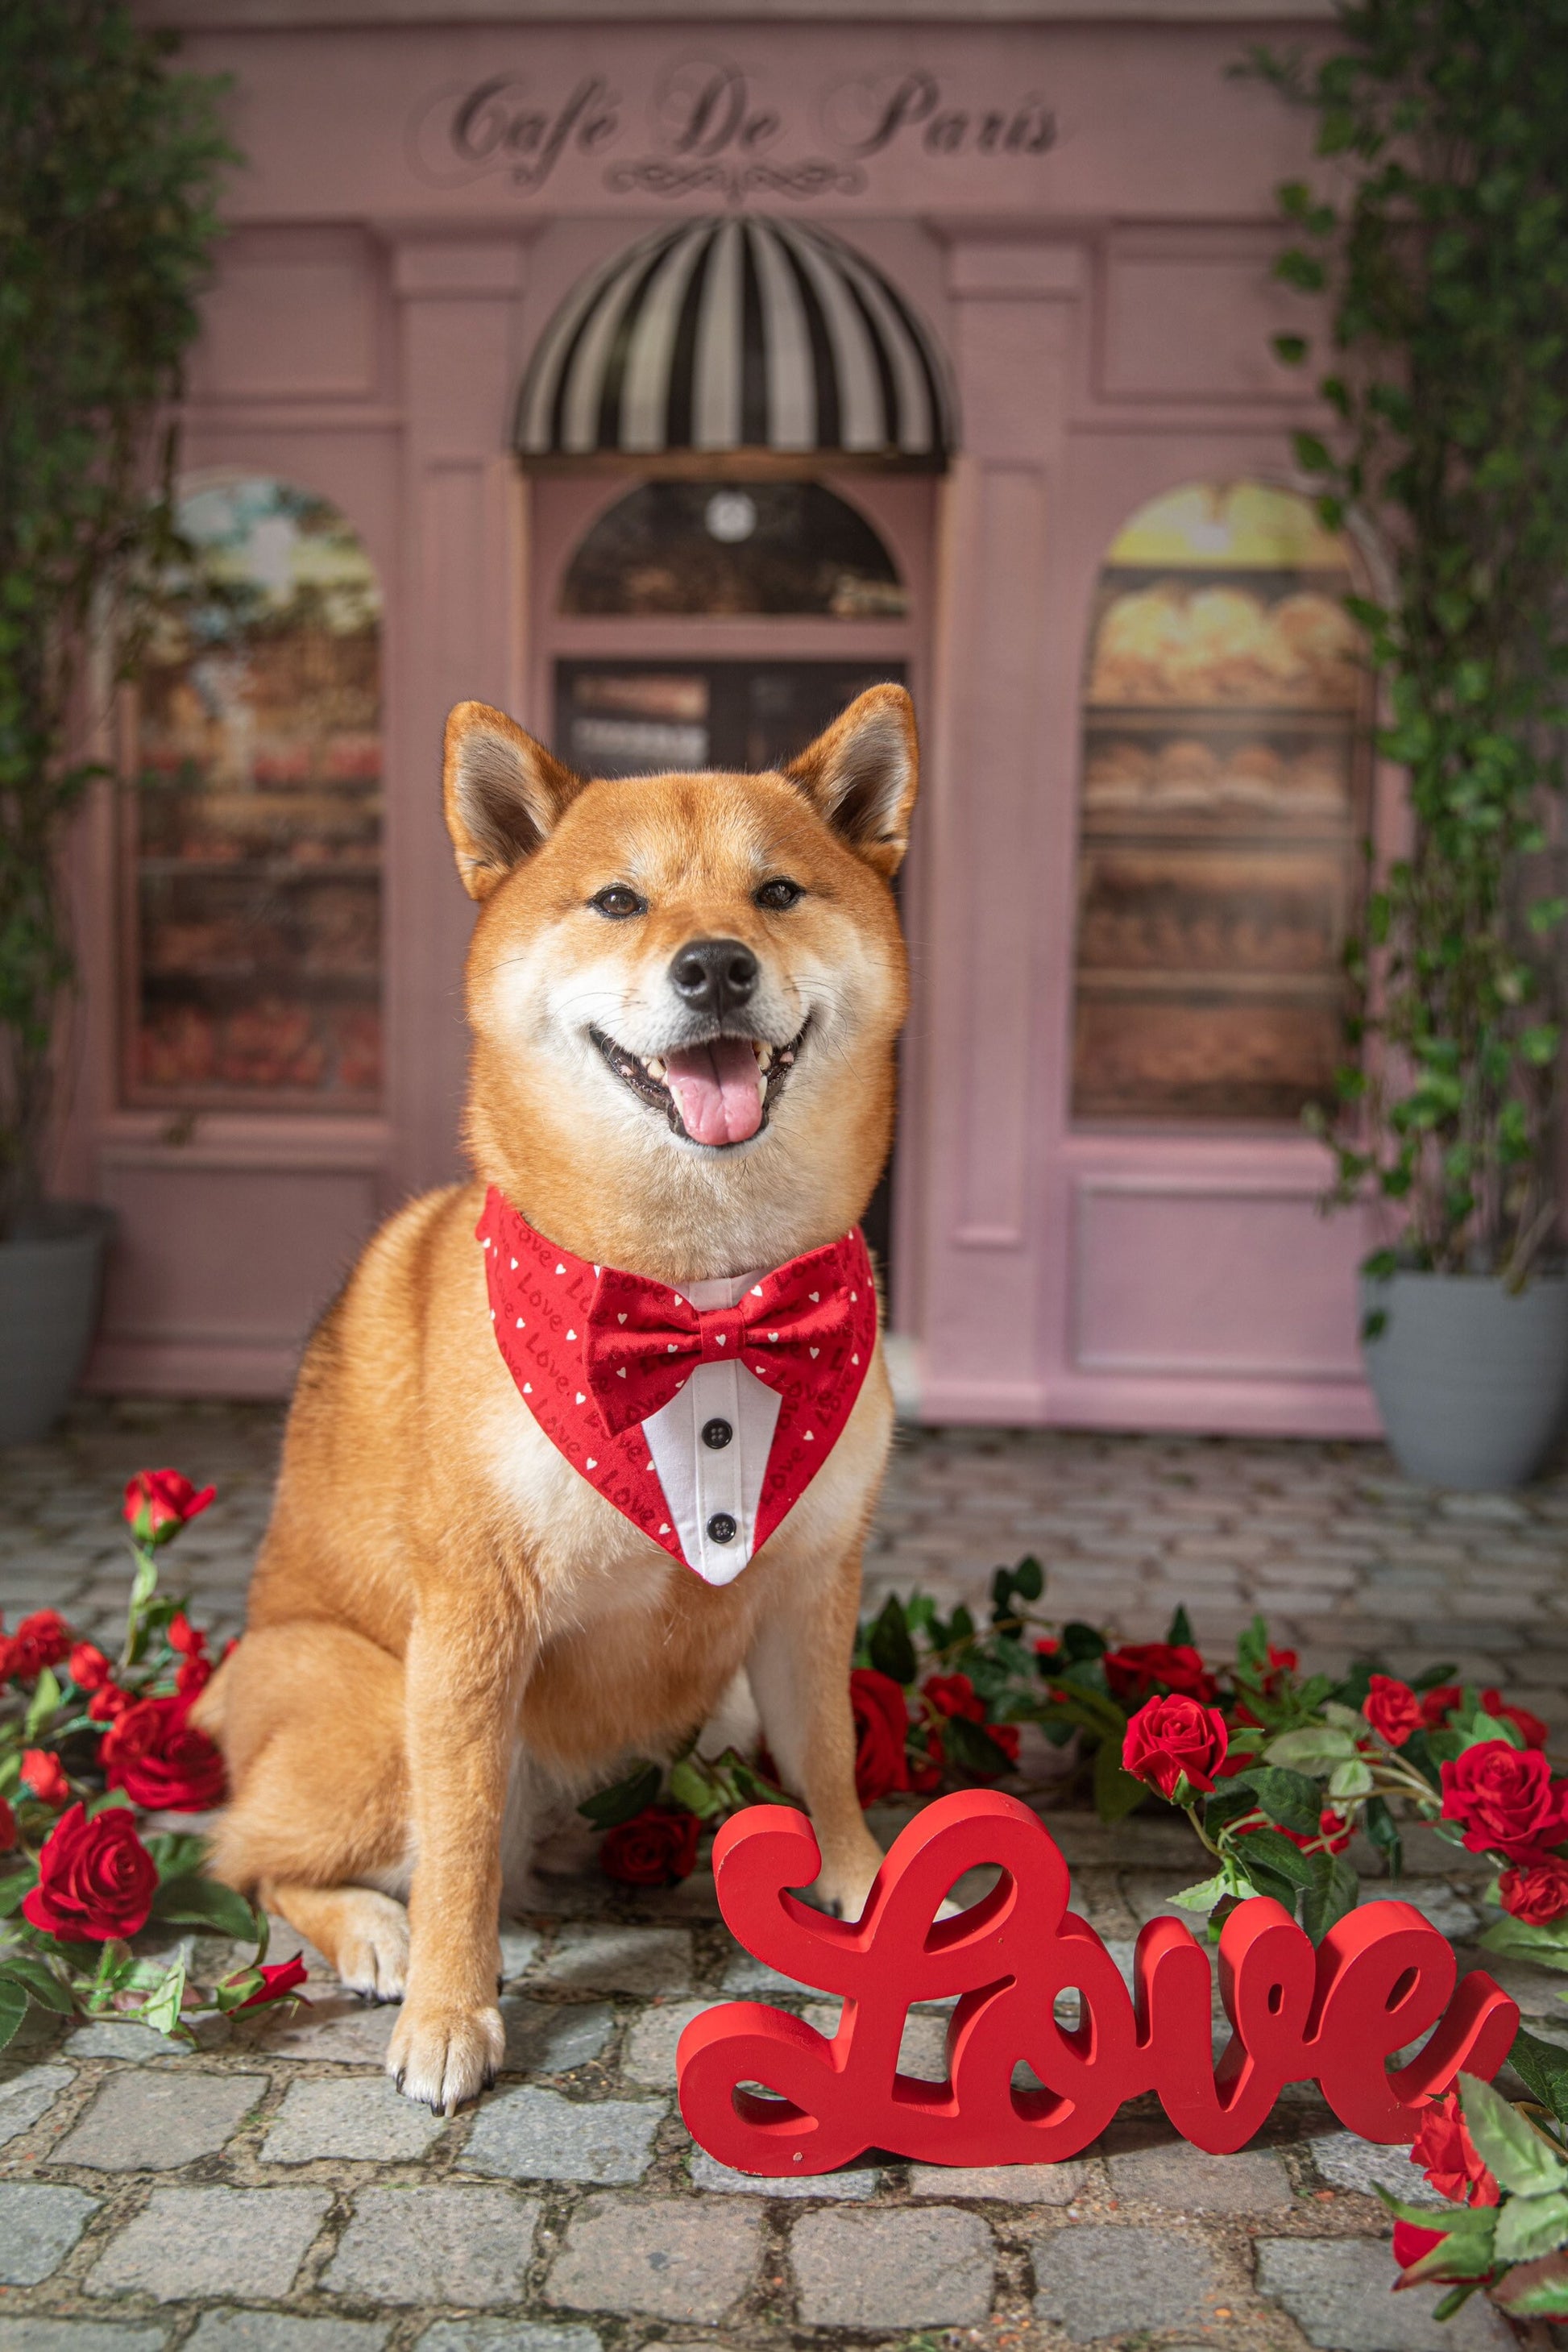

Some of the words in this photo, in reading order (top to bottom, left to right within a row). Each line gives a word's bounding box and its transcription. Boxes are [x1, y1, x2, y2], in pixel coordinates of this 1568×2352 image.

[654, 48, 779, 160] De
[516, 1271, 563, 1333] Love
[525, 1331, 570, 1394] Love
[533, 1398, 581, 1459] Love
[606, 1391, 668, 1438] Love
[596, 1469, 656, 1527] Love
[678, 1788, 1520, 2177] Love
